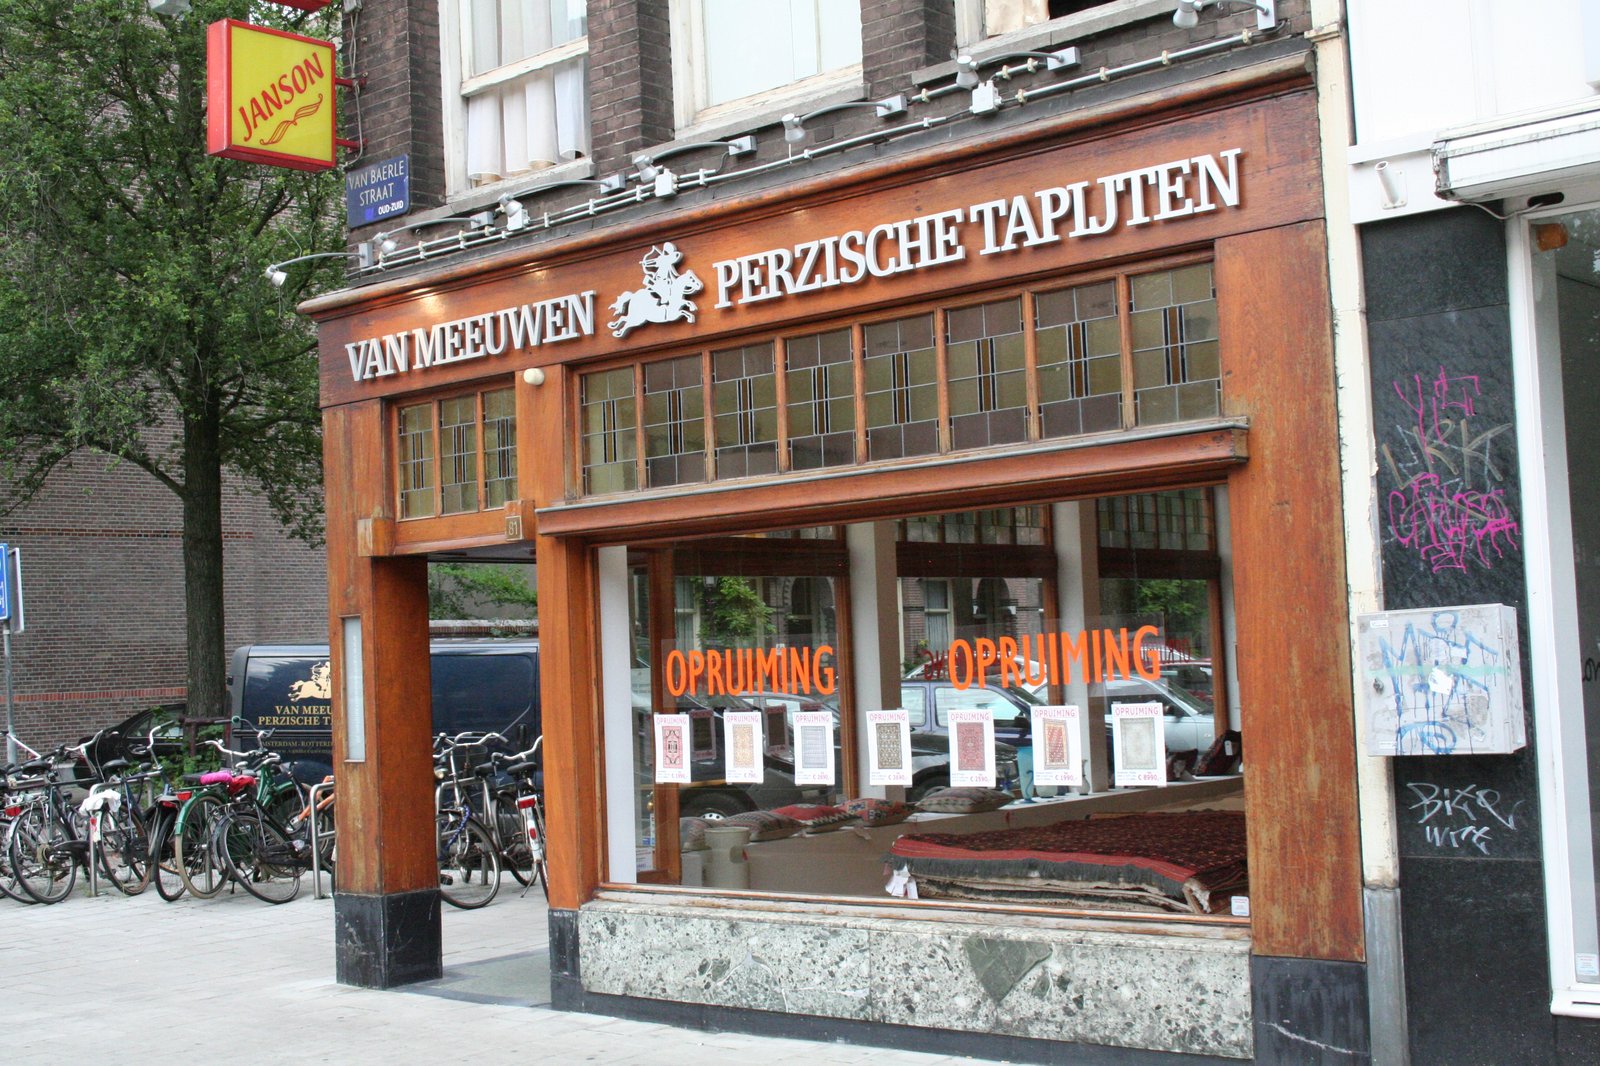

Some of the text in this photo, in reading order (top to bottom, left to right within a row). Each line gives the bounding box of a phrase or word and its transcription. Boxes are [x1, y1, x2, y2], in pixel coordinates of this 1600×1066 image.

[238, 52, 324, 142] JANSON
[349, 160, 404, 190] VAN BAERLE
[360, 182, 394, 207] STRAAT
[378, 199, 404, 215] OUD-ZUID
[344, 148, 1242, 382] VAN MEEUWEN PERZISCHE TAPIJTEN
[508, 520, 518, 536] 81
[949, 624, 1161, 690] OPRUIMING
[665, 645, 835, 697] OPRUIMING
[274, 705, 299, 715] VAN
[869, 713, 906, 721] OPRUIMING
[950, 712, 990, 721] OPRUIMING
[1034, 709, 1076, 718] OPRUIMING
[1114, 706, 1159, 716] OPRUIMING
[258, 716, 320, 726] PERZISCHE
[795, 714, 830, 723] OPRUIMING
